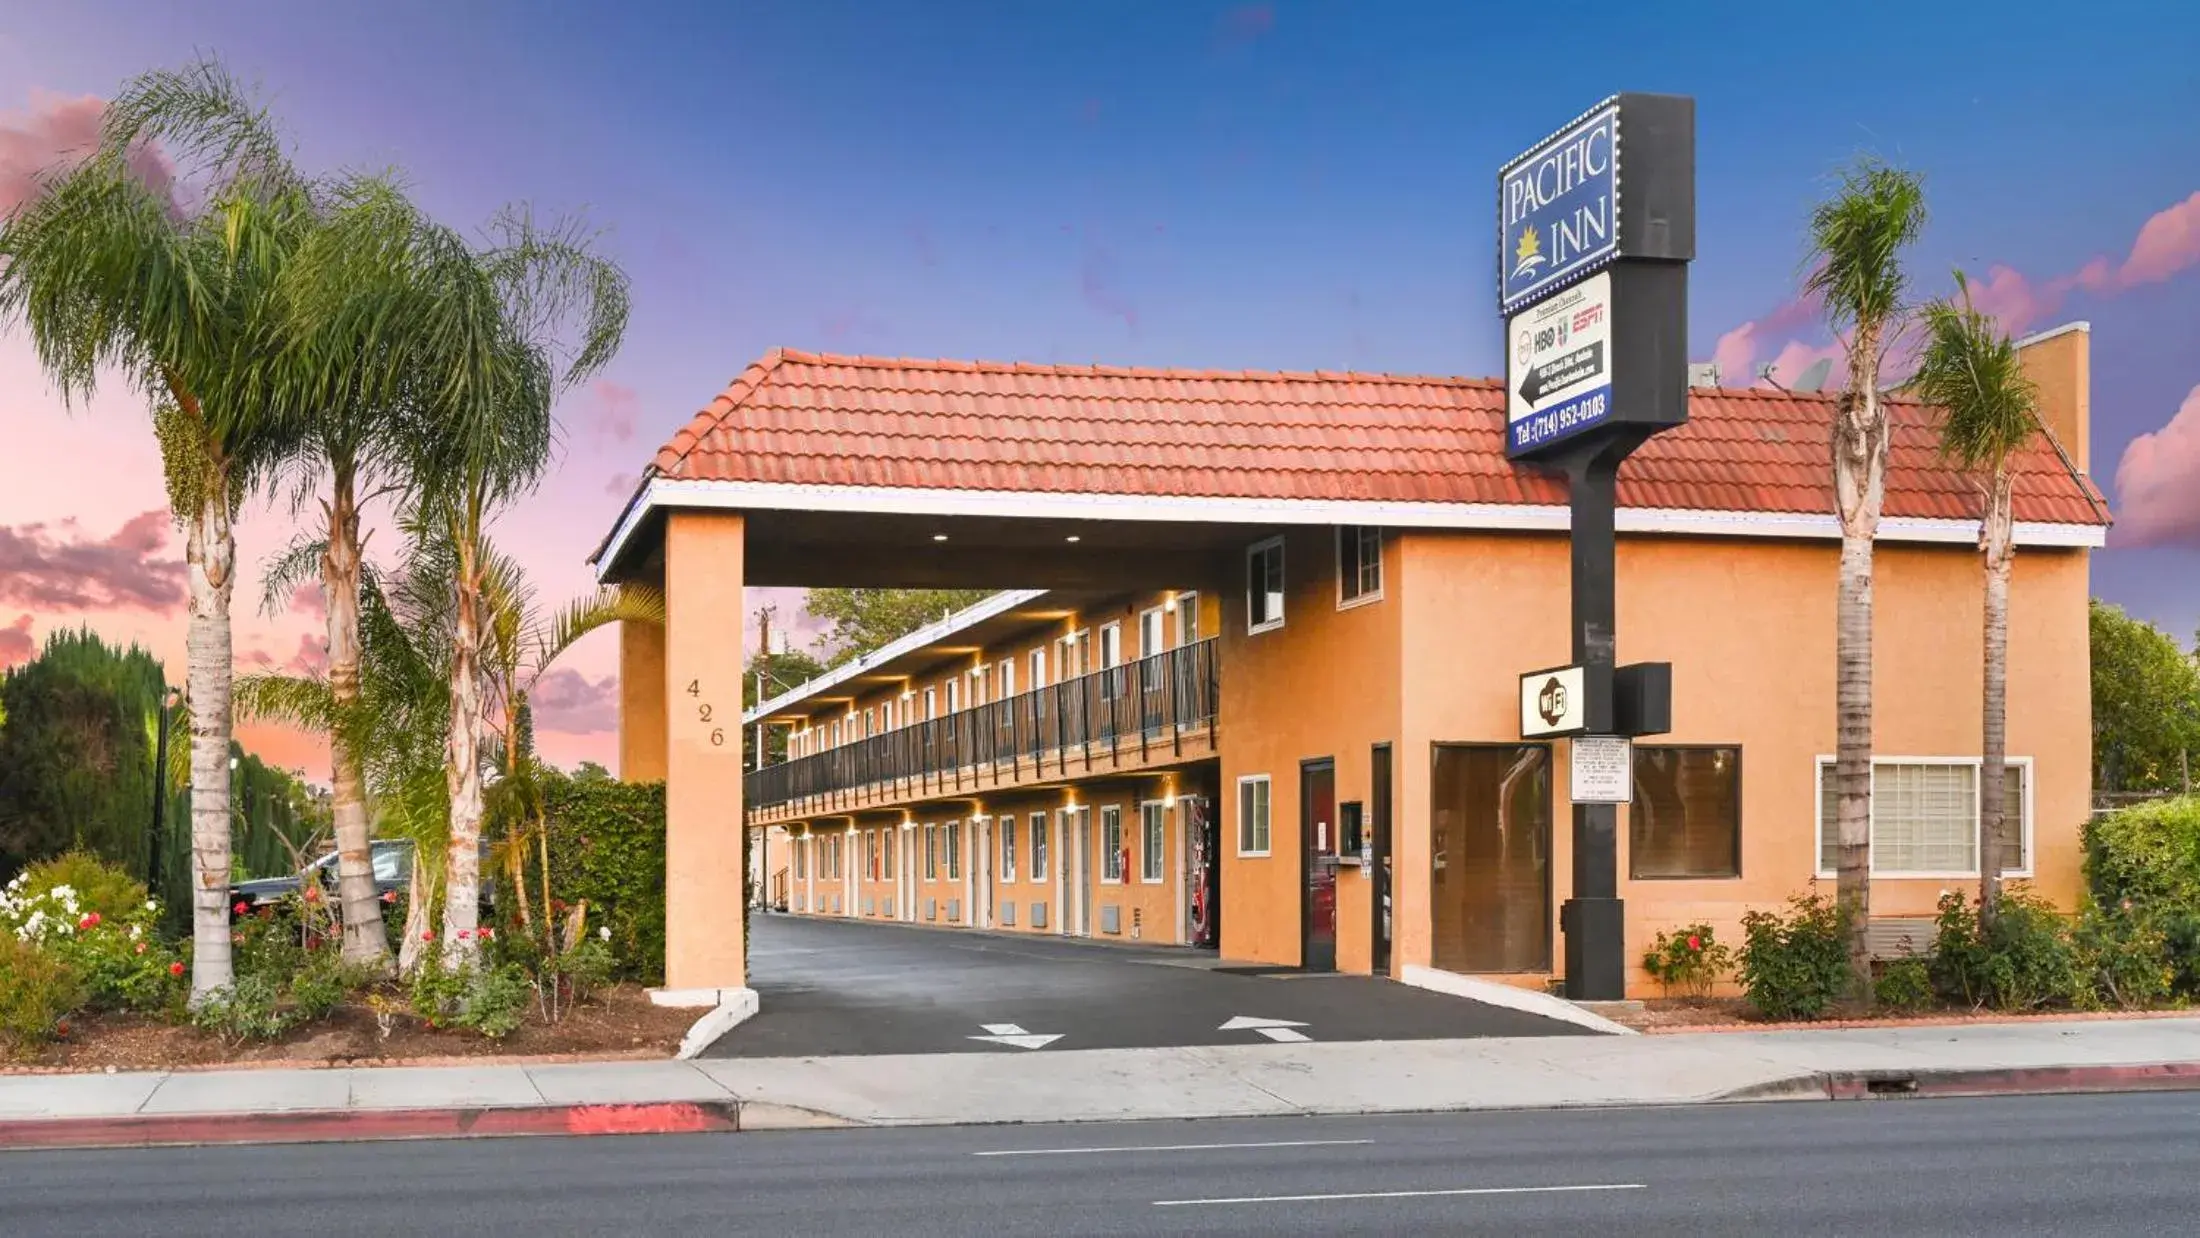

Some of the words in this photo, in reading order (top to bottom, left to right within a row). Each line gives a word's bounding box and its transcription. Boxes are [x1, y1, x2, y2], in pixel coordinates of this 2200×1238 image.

[1510, 126, 1607, 225] PACIFIC
[1551, 195, 1606, 268] INN
[1534, 326, 1555, 354] HBO
[1516, 421, 1530, 446] Tel
[1560, 393, 1605, 430] 952-0103
